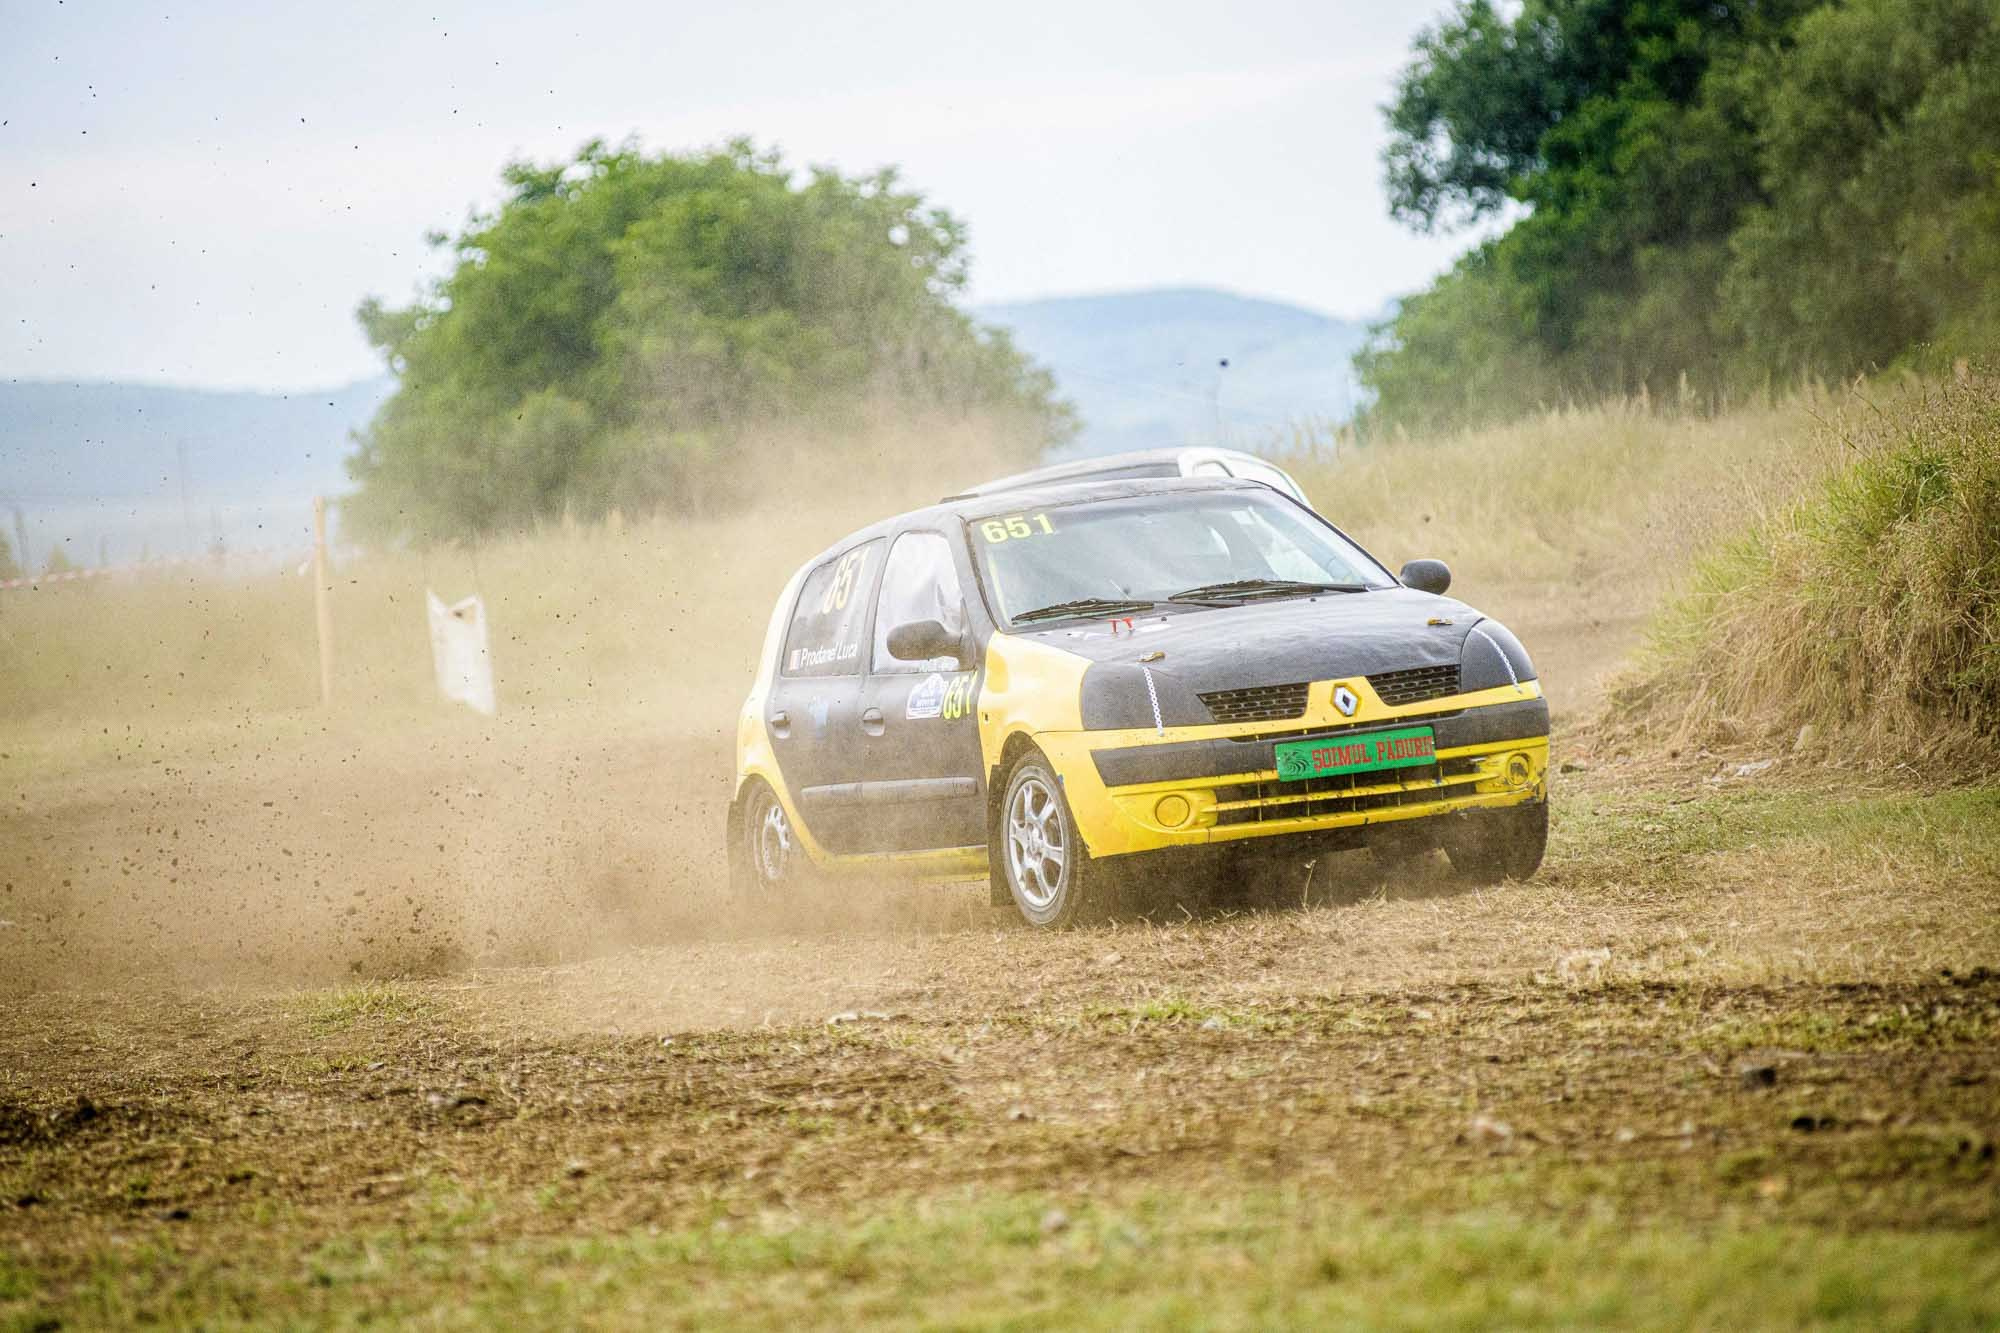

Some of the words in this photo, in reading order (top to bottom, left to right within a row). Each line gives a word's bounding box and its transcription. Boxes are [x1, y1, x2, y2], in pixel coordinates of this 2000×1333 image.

[981, 513, 1053, 544] 651
[837, 640, 858, 661] Luca
[943, 670, 979, 720] 651
